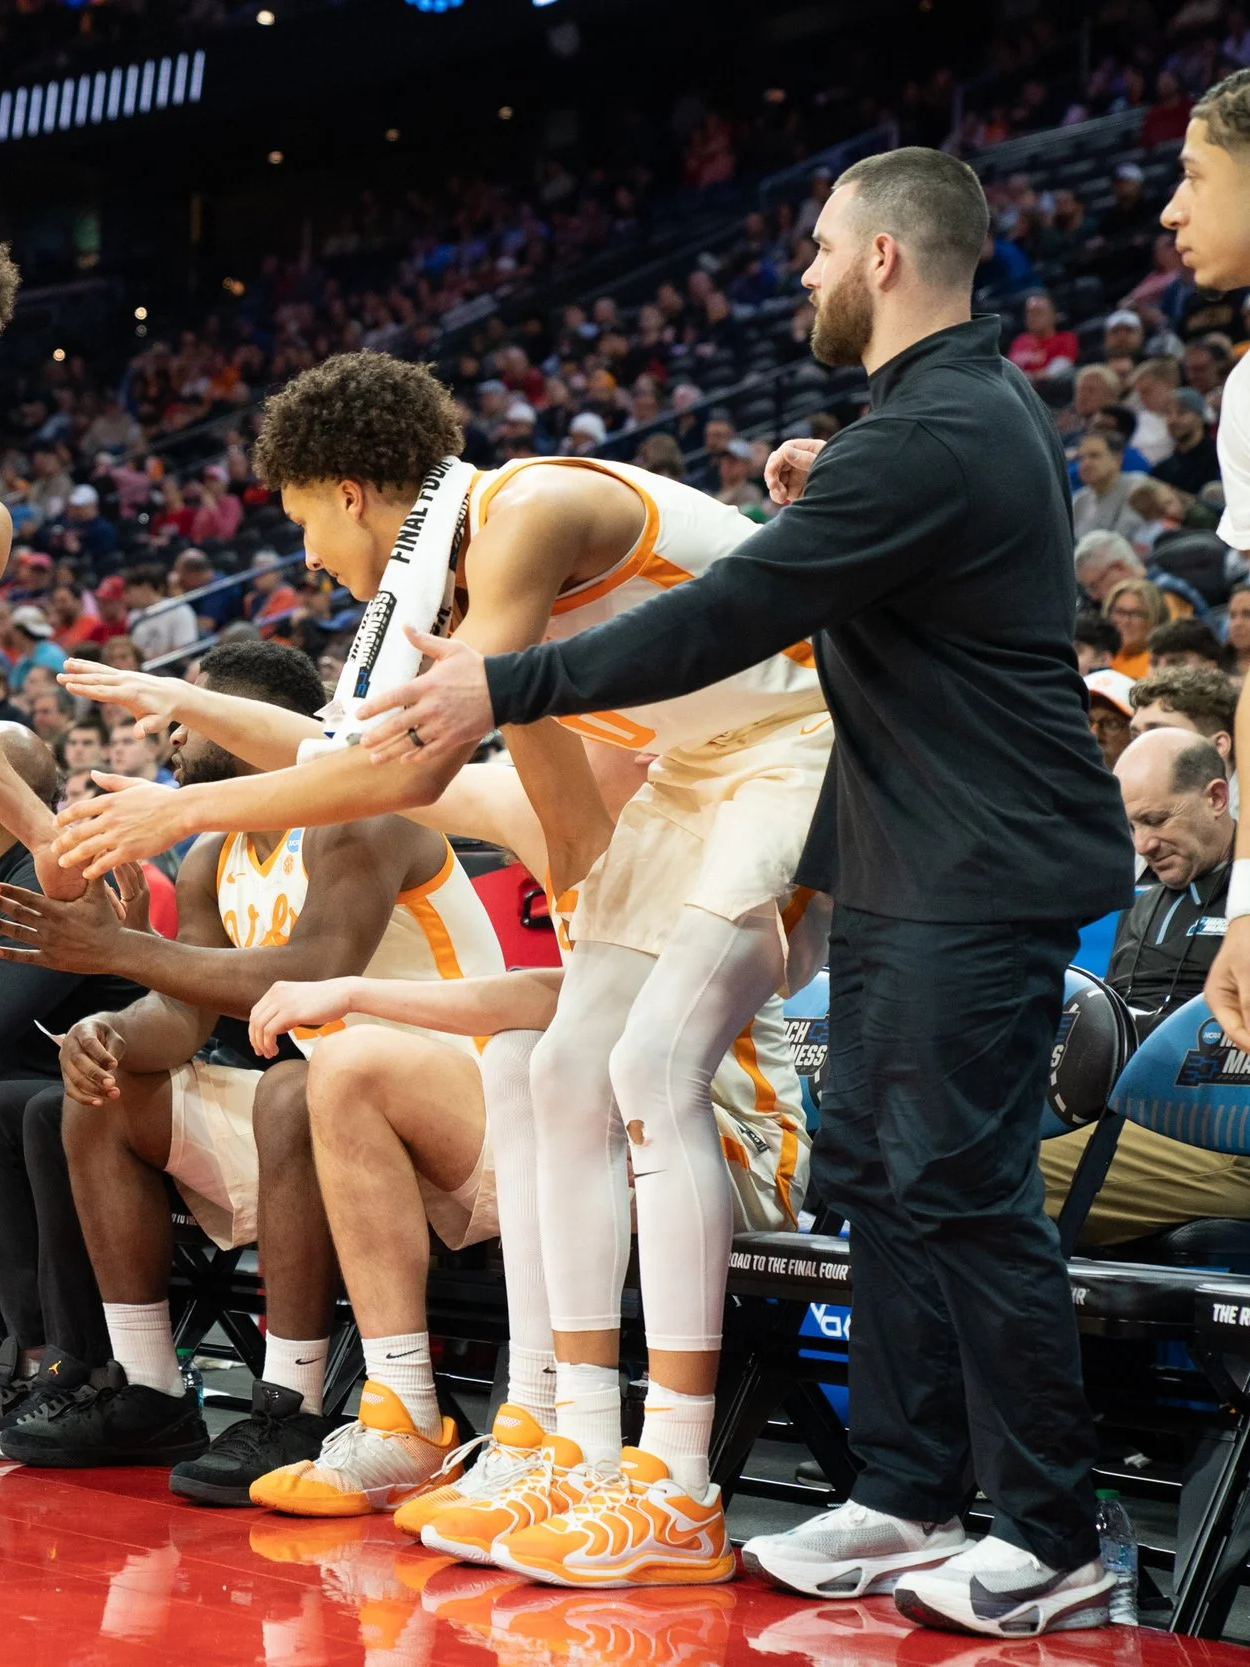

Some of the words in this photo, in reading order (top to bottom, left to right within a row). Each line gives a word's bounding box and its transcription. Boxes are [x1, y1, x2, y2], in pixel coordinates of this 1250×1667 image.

[752, 1255, 766, 1271] TO
[767, 1256, 788, 1274] THE
[788, 1259, 817, 1277] FINAL
[819, 1262, 848, 1280] FOUR
[1212, 1303, 1239, 1325] THE
